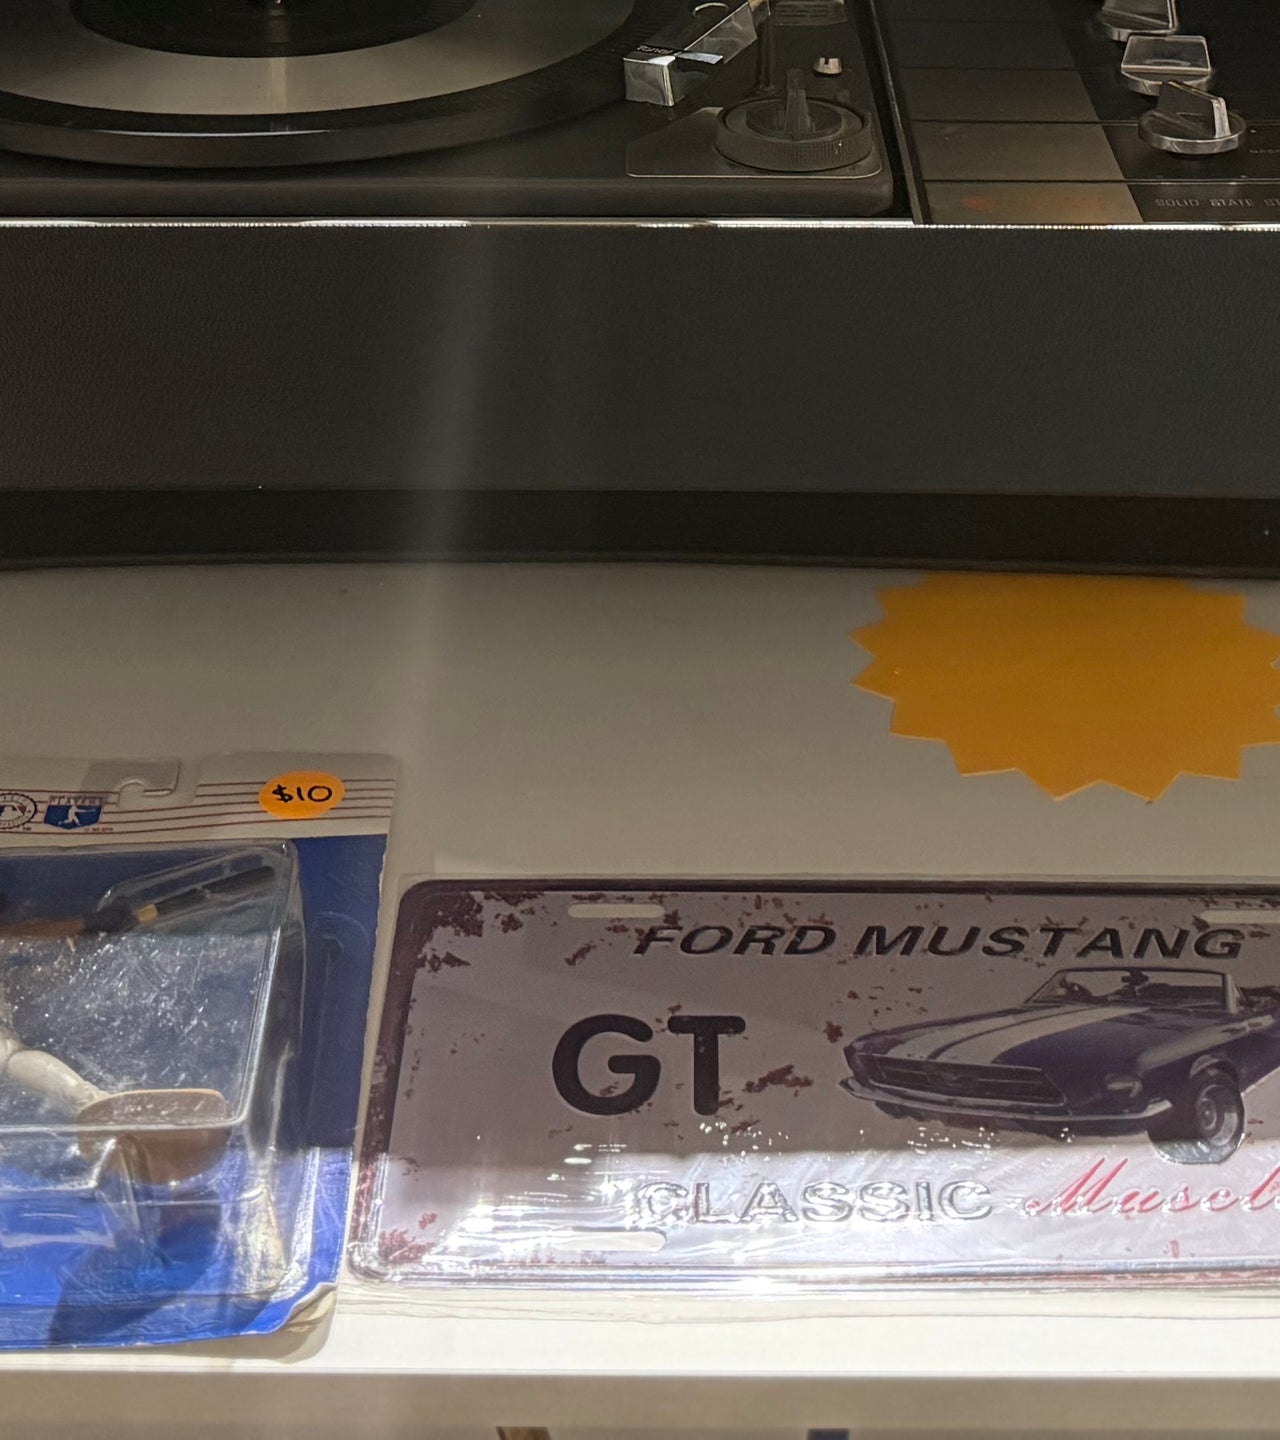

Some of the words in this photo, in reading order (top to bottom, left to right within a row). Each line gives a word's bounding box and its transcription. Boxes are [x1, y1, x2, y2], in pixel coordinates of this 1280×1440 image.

[271, 782, 333, 804] $10
[634, 925, 837, 956] FORD
[853, 925, 1246, 960] MUSTANG
[551, 1012, 747, 1117] GT
[628, 1179, 993, 1225] CLASSIC
